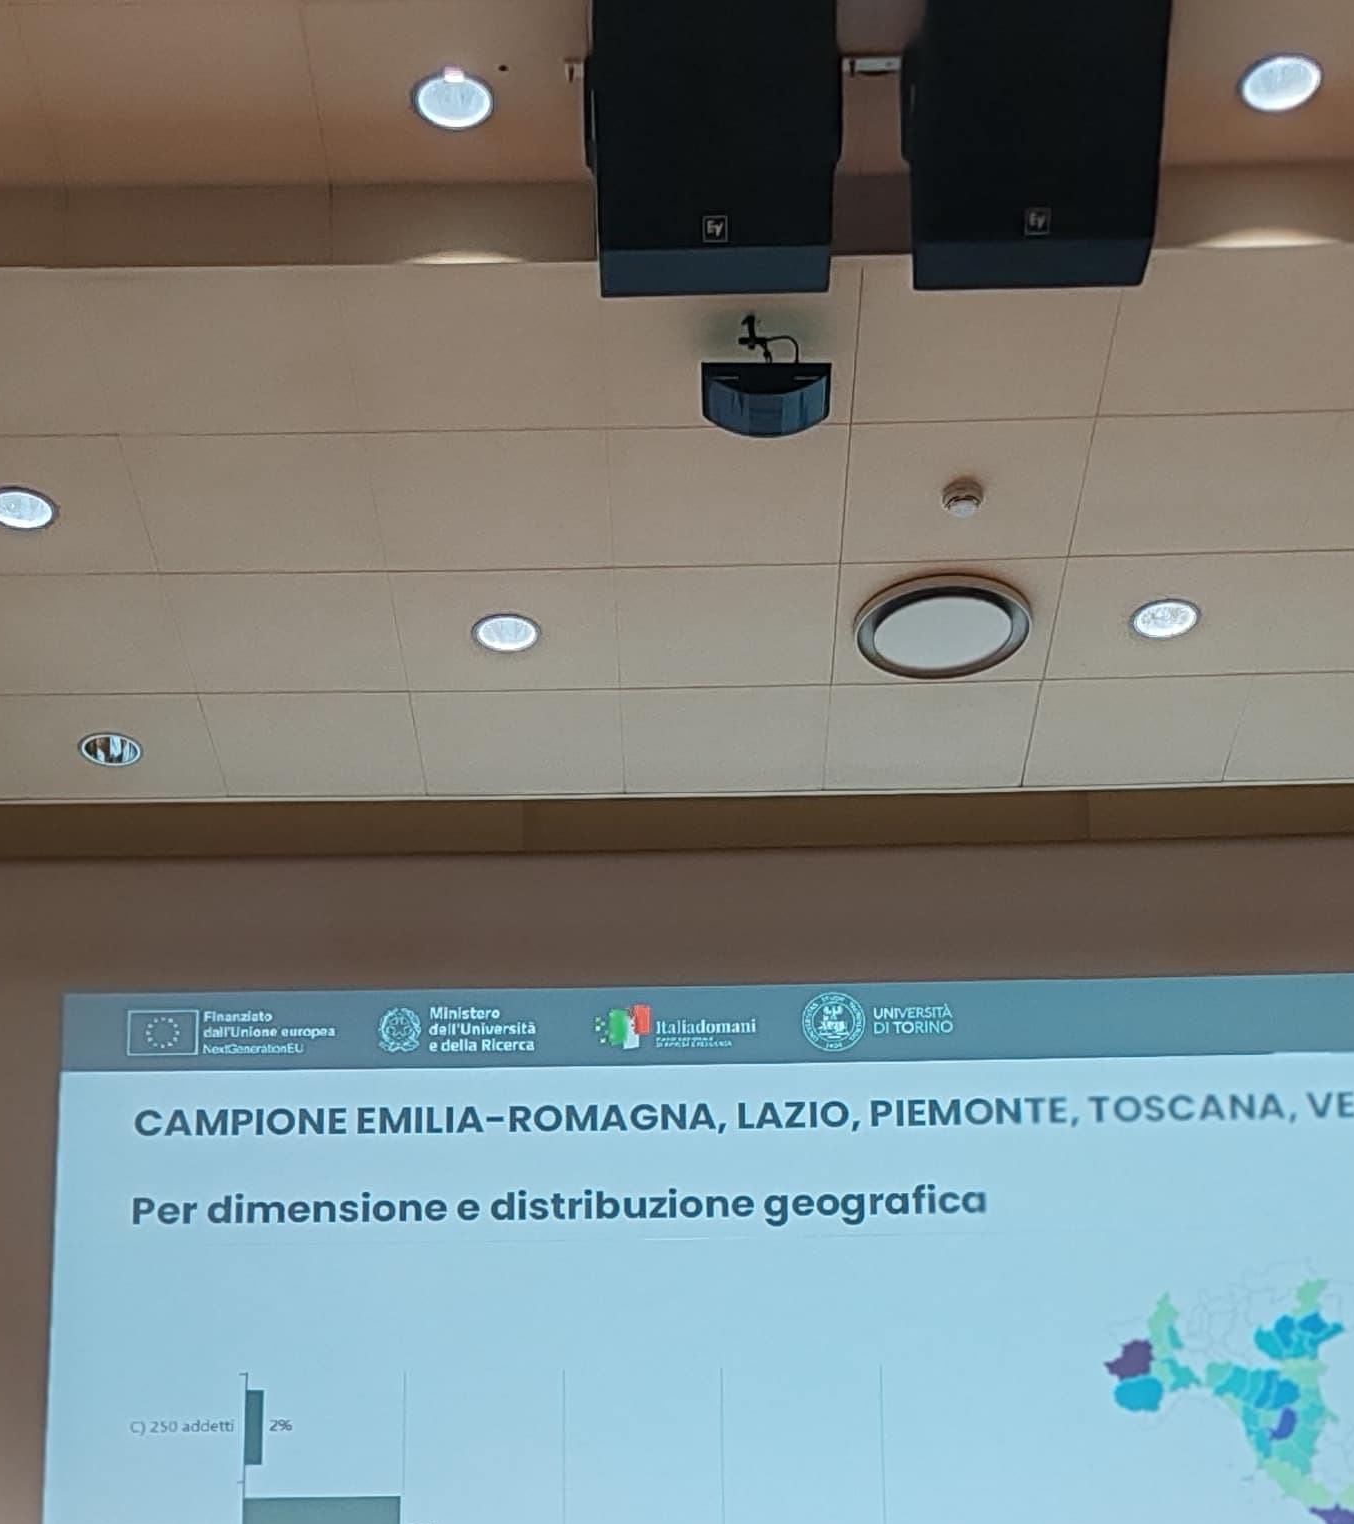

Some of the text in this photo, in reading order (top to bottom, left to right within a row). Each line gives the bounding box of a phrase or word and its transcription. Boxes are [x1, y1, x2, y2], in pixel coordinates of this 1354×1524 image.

[203, 1010, 273, 1023] Finanziato
[429, 1006, 501, 1020] Ministero
[873, 1003, 953, 1020] UNIVERSITÀ
[203, 1026, 336, 1040] dall'Unione europea
[428, 1021, 537, 1036] dell'Università
[656, 1018, 757, 1035] Italiadomani
[873, 1020, 954, 1035] DI TORINO
[429, 1038, 535, 1052] e della Ricerca
[133, 1107, 347, 1138] CAMPIONE
[356, 1101, 727, 1136] EMILIA-ROMAGNA,
[737, 1100, 860, 1133] LAZIO,
[870, 1096, 1080, 1128] PIEMONTE,
[1089, 1093, 1298, 1125] TOSCANA,
[132, 1184, 987, 1227] Per dimensione e distribuzione geografica
[149, 1421, 178, 1433] 250
[182, 1419, 235, 1433] addetti
[269, 1419, 293, 1432] 2%
